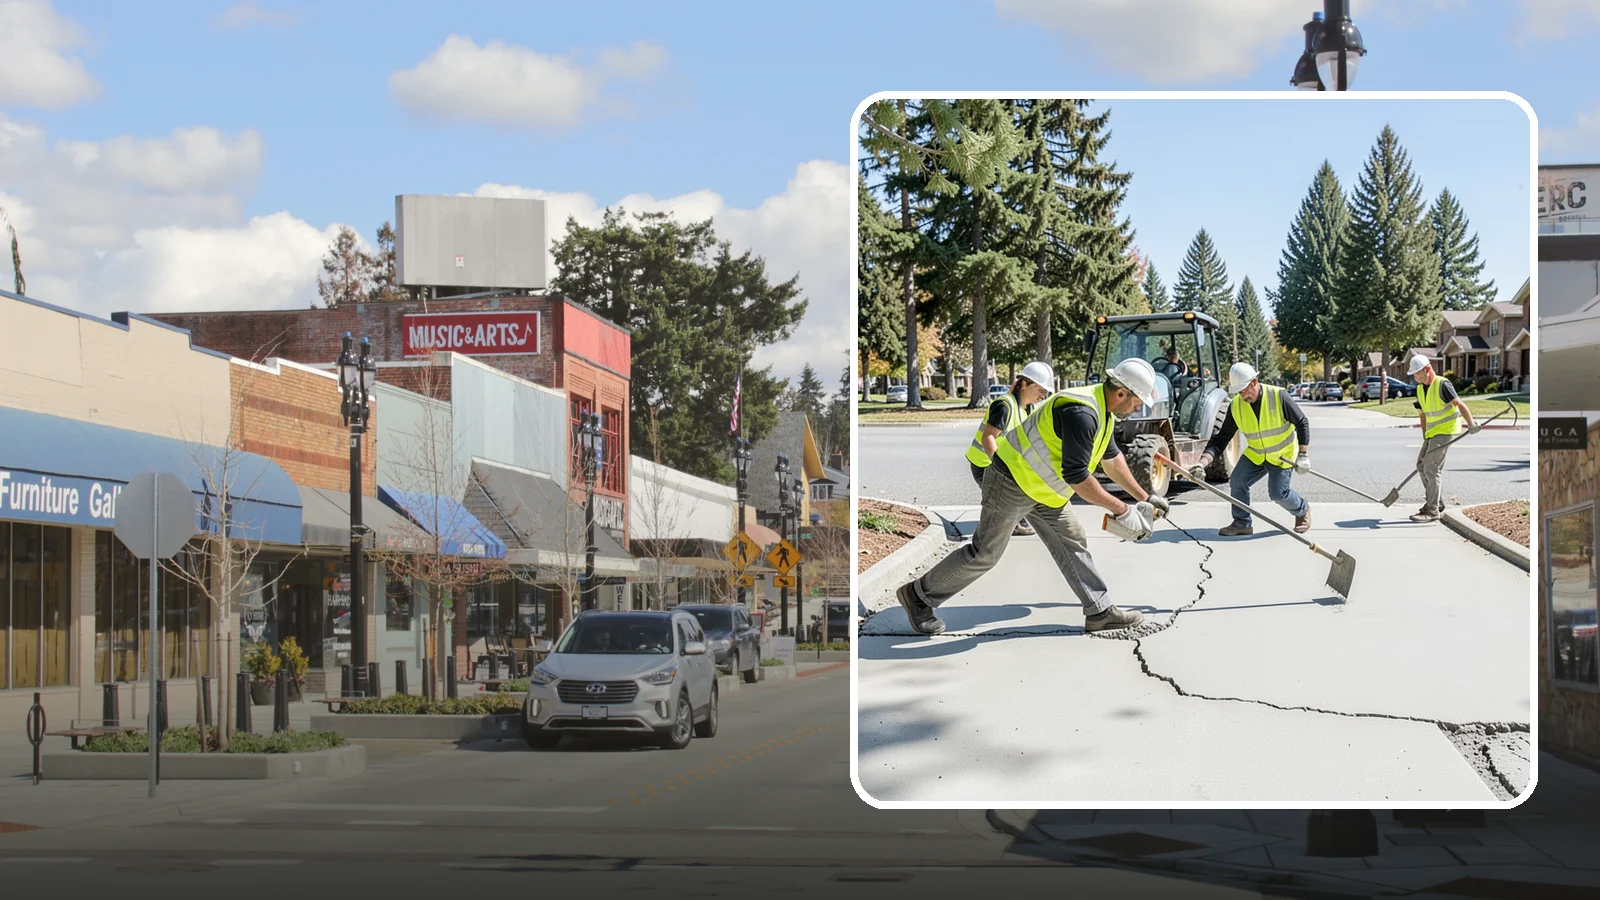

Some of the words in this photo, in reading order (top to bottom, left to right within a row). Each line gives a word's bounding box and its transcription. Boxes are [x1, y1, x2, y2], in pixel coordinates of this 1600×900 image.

[409, 323, 519, 349] MUSIC&ARTS
[0, 471, 79, 515] Furniture
[453, 563, 479, 574] SUSHI
